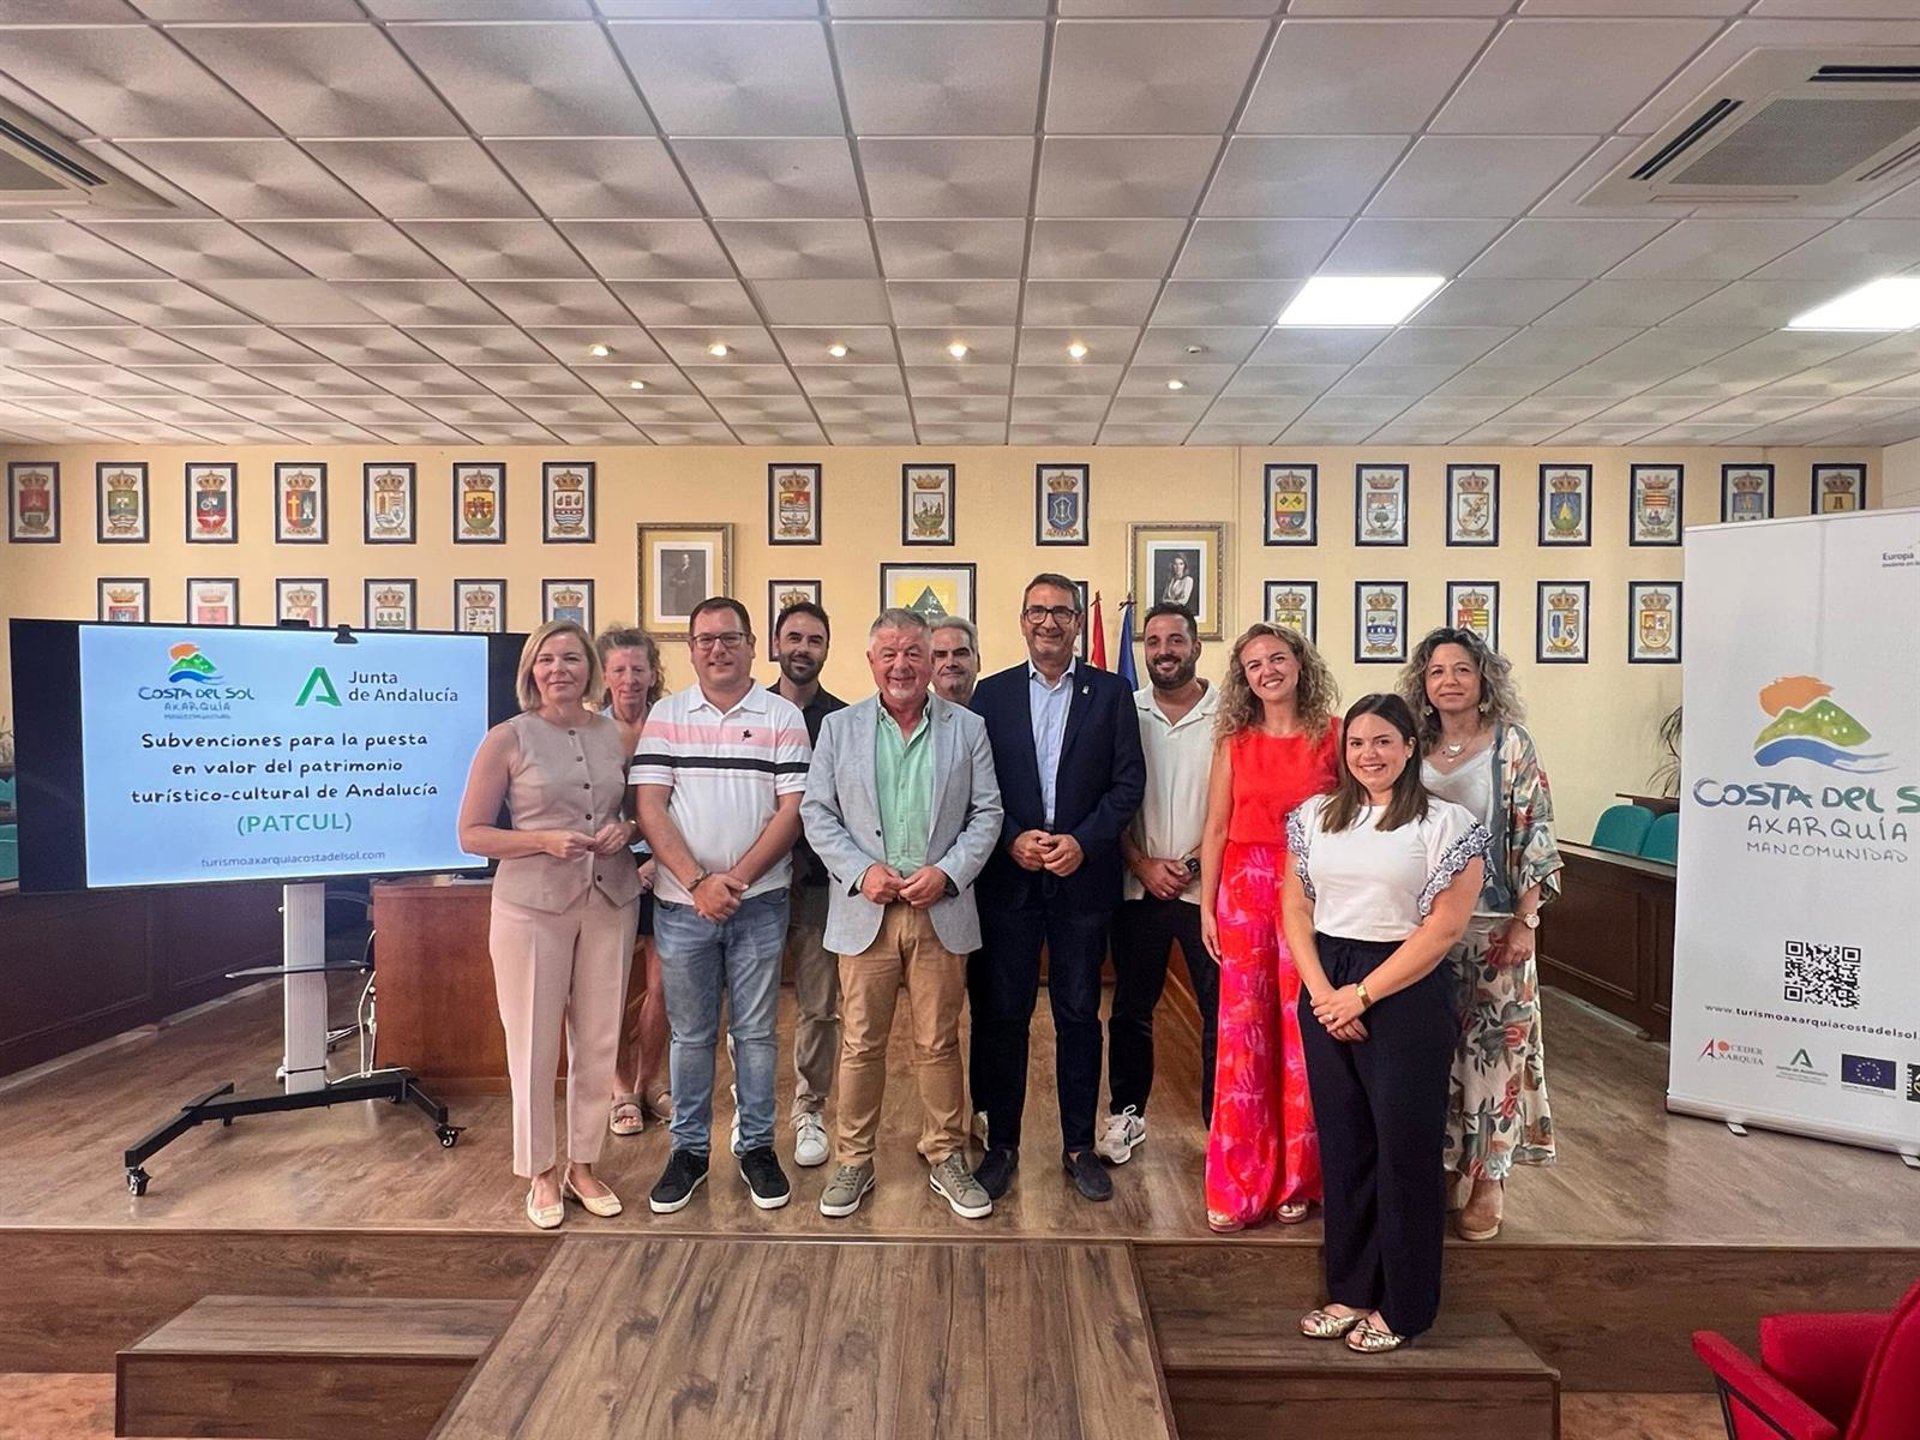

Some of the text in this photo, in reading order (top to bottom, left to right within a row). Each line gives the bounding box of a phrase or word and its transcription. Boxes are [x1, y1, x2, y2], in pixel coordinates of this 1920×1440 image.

[1882, 552, 1914, 561] Europa
[348, 671, 398, 684] Junta
[138, 686, 193, 700] COSTA
[348, 687, 458, 702] de Andalucía
[141, 732, 428, 751] Subvenciones para la puesta
[172, 758, 403, 778] en valor del patrimonio
[131, 782, 438, 804] turístico-cultural de Andalucía
[1693, 777, 1813, 811] COSTA
[236, 812, 353, 837] (PATCUL)
[1748, 815, 1908, 843] AXARQUÍA
[201, 850, 386, 868] turismoaxarquiacostadelsol.com
[1746, 841, 1909, 864] MANCOMUNIDAD
